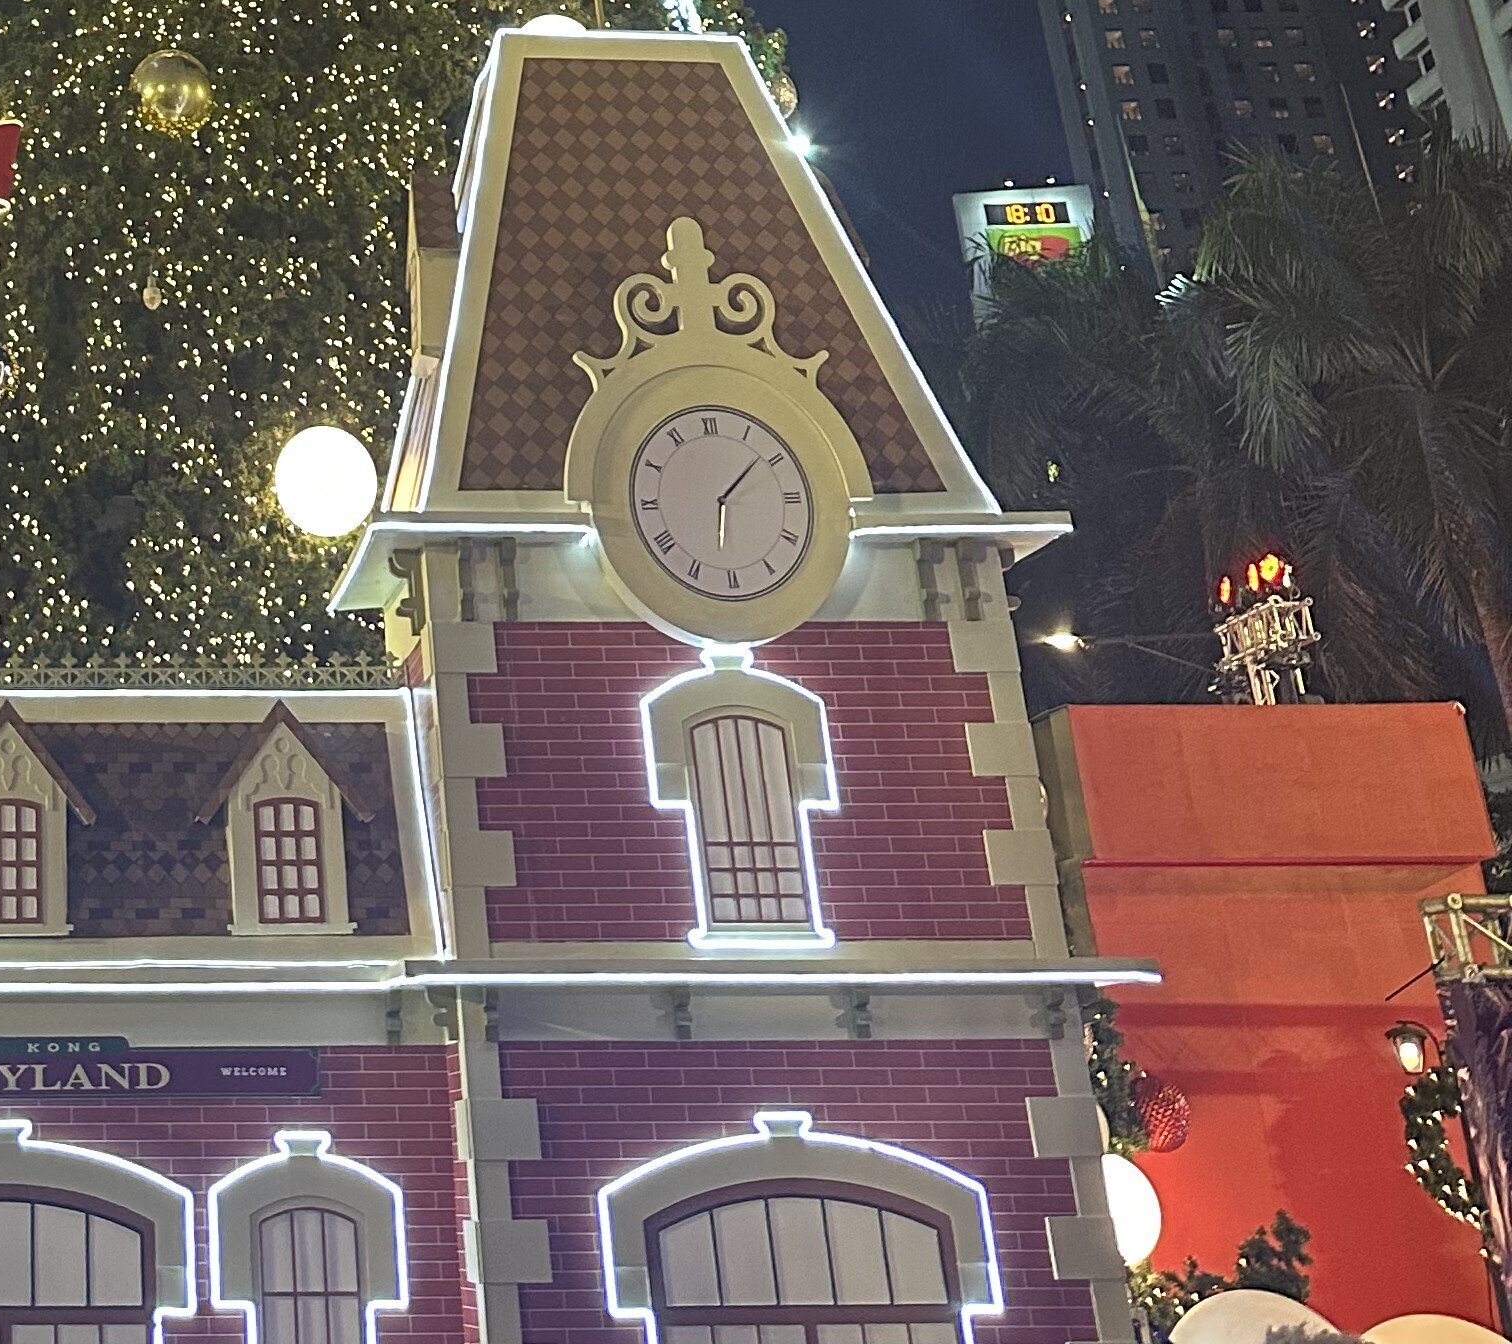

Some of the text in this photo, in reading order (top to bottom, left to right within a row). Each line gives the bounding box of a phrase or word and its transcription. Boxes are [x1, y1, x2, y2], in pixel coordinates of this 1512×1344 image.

[1005, 202, 1056, 224] 18:10
[701, 417, 718, 435] XII
[26, 1042, 102, 1053] KONG
[220, 1067, 287, 1076] WELCOME
